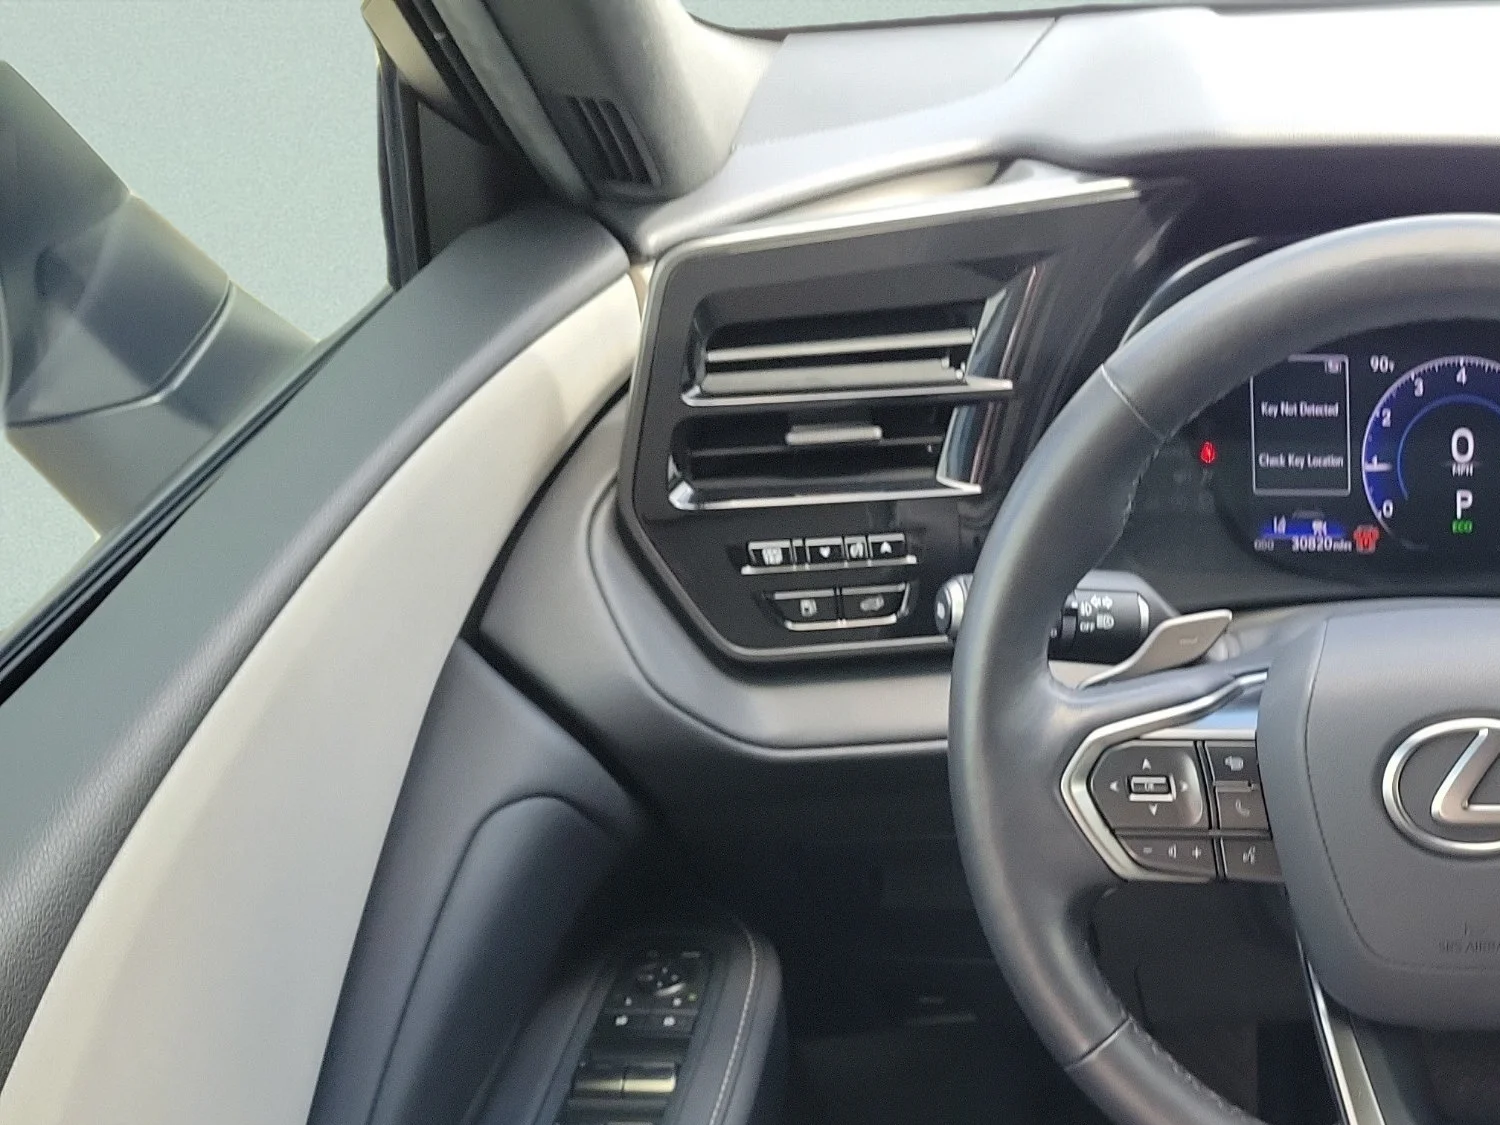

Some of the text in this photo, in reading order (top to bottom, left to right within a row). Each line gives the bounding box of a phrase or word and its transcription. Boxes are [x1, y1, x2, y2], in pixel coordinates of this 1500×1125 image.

[1456, 367, 1467, 386] 4
[1414, 377, 1424, 397] 3
[1261, 401, 1338, 418] Key Not Detected
[1382, 408, 1391, 427] 2
[1451, 427, 1475, 464] 0
[1258, 453, 1344, 470] Check Key Location
[1382, 500, 1394, 518] 0
[1456, 489, 1473, 519] P
[1452, 519, 1473, 534] ECO
[1080, 621, 1095, 632] OFF
